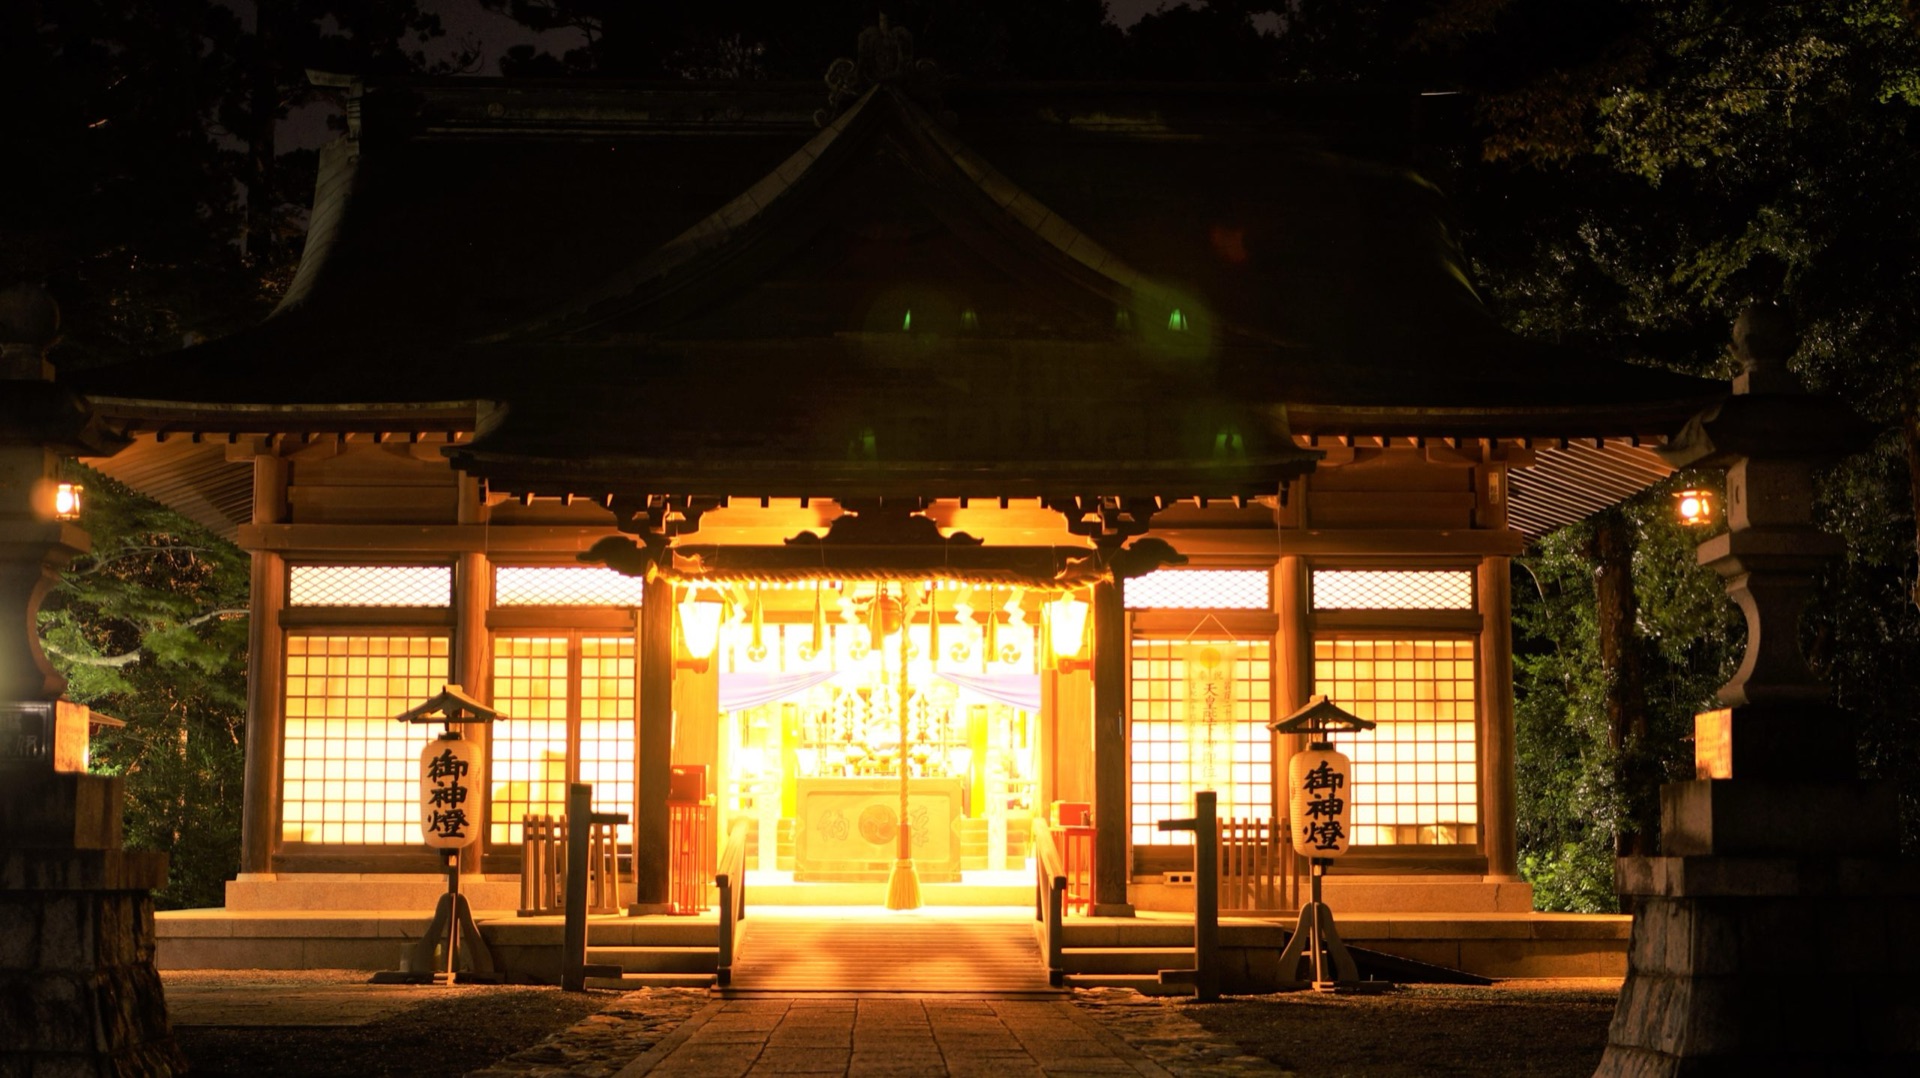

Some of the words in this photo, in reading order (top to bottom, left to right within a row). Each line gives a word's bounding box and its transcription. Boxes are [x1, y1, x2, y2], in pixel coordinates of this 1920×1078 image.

[427, 748, 469, 838] 御神燈
[1303, 760, 1345, 850] 御神燈
